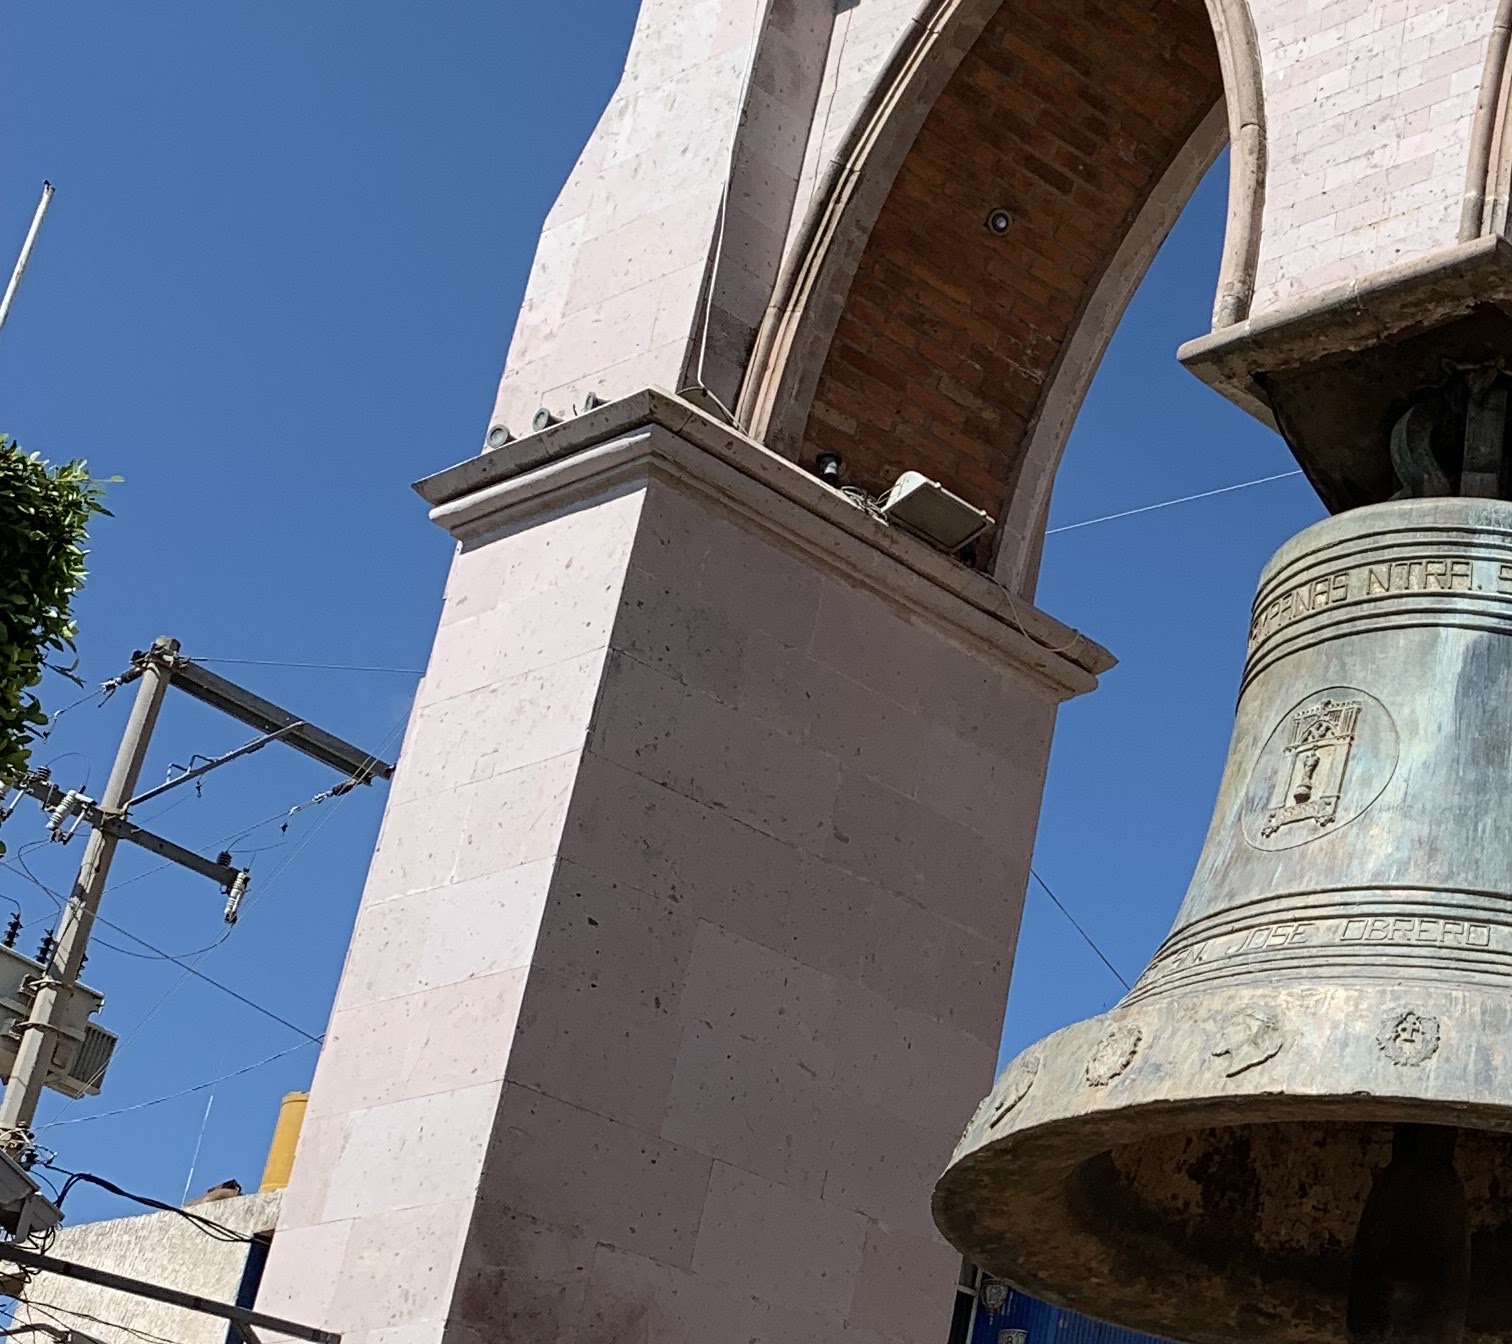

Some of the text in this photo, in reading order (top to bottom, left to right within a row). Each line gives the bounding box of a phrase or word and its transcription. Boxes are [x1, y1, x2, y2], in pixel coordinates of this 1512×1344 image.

[1366, 559, 1483, 596] NTRA.
[1226, 922, 1315, 956] JOSE
[1339, 919, 1492, 948] OBRERO
